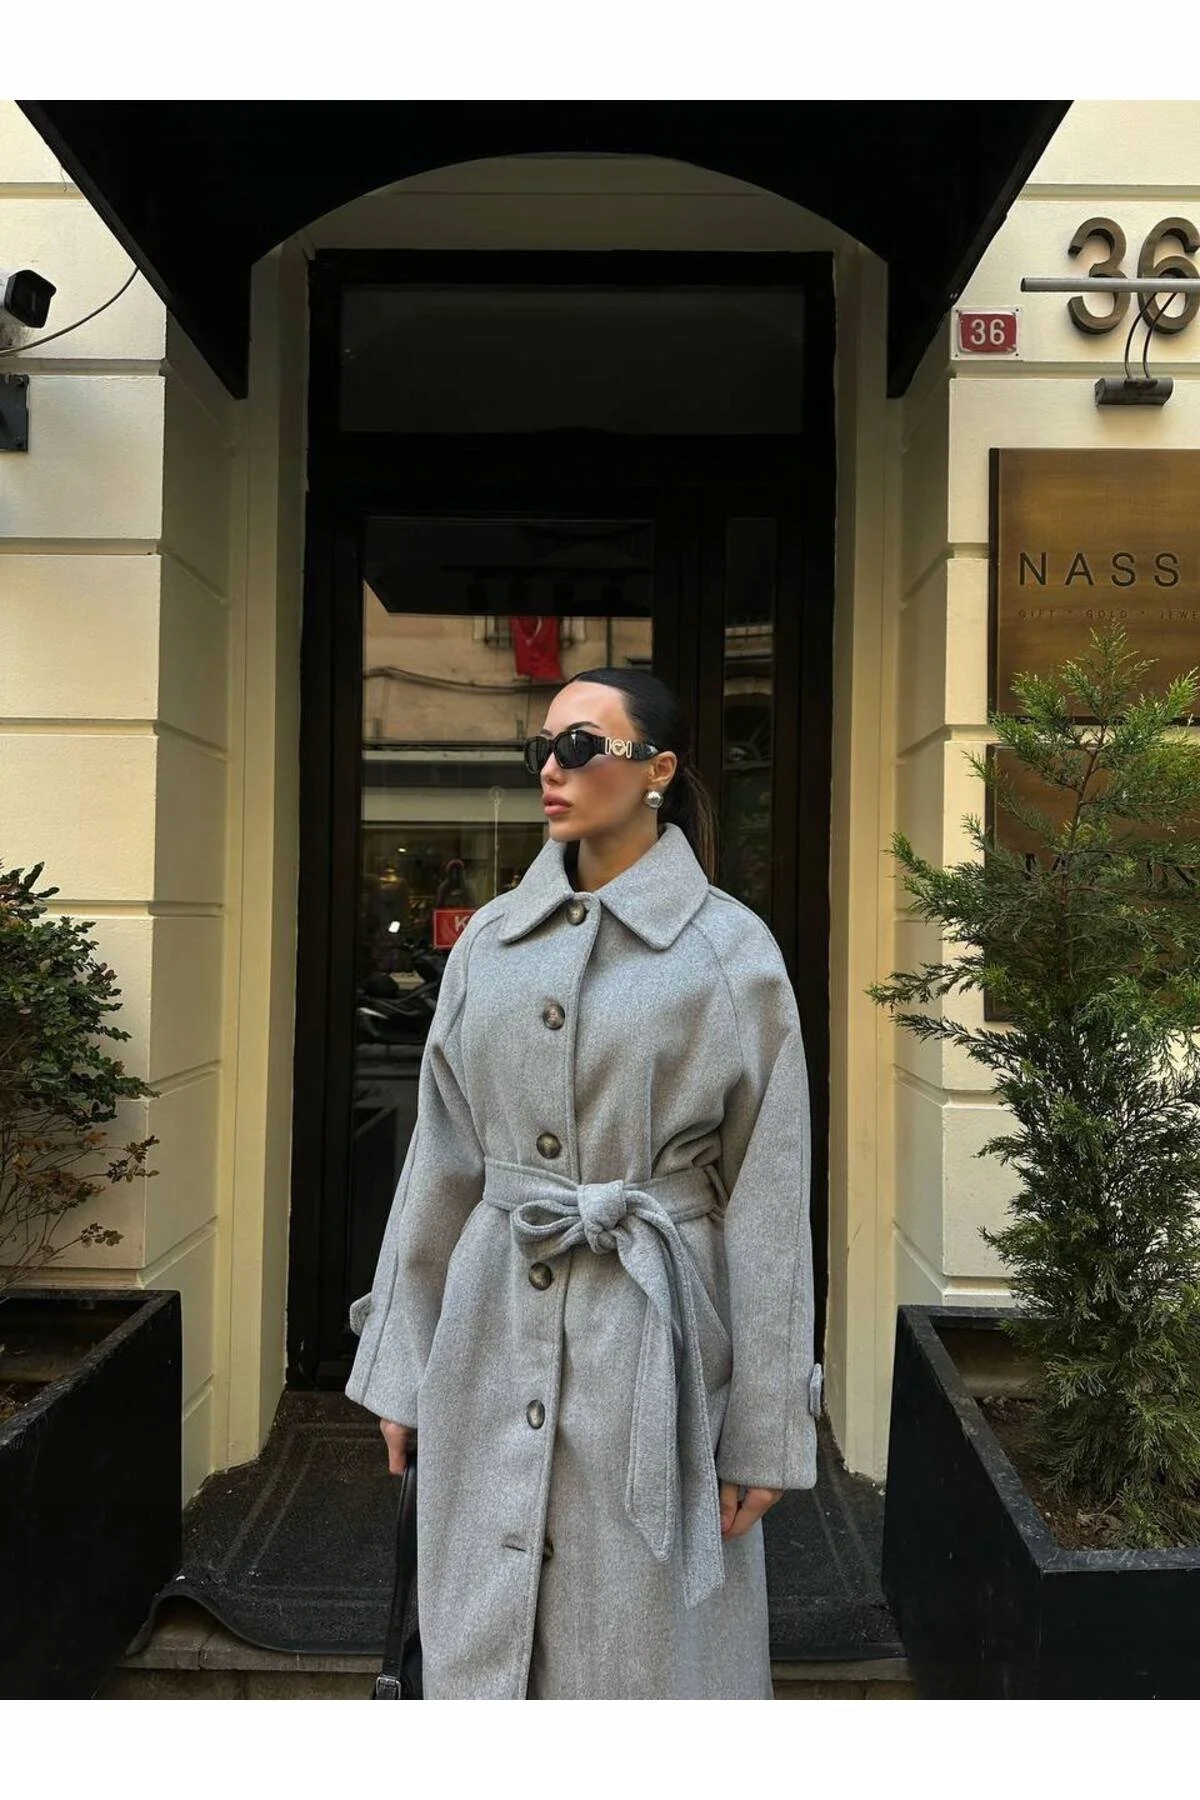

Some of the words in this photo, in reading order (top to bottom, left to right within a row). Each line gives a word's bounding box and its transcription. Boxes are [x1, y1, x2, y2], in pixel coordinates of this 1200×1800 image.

[1067, 216, 1200, 335] 36
[970, 318, 1006, 346] 36
[1018, 551, 1181, 588] NASS
[1018, 607, 1055, 619] GIFT
[1086, 607, 1129, 619] GOLD
